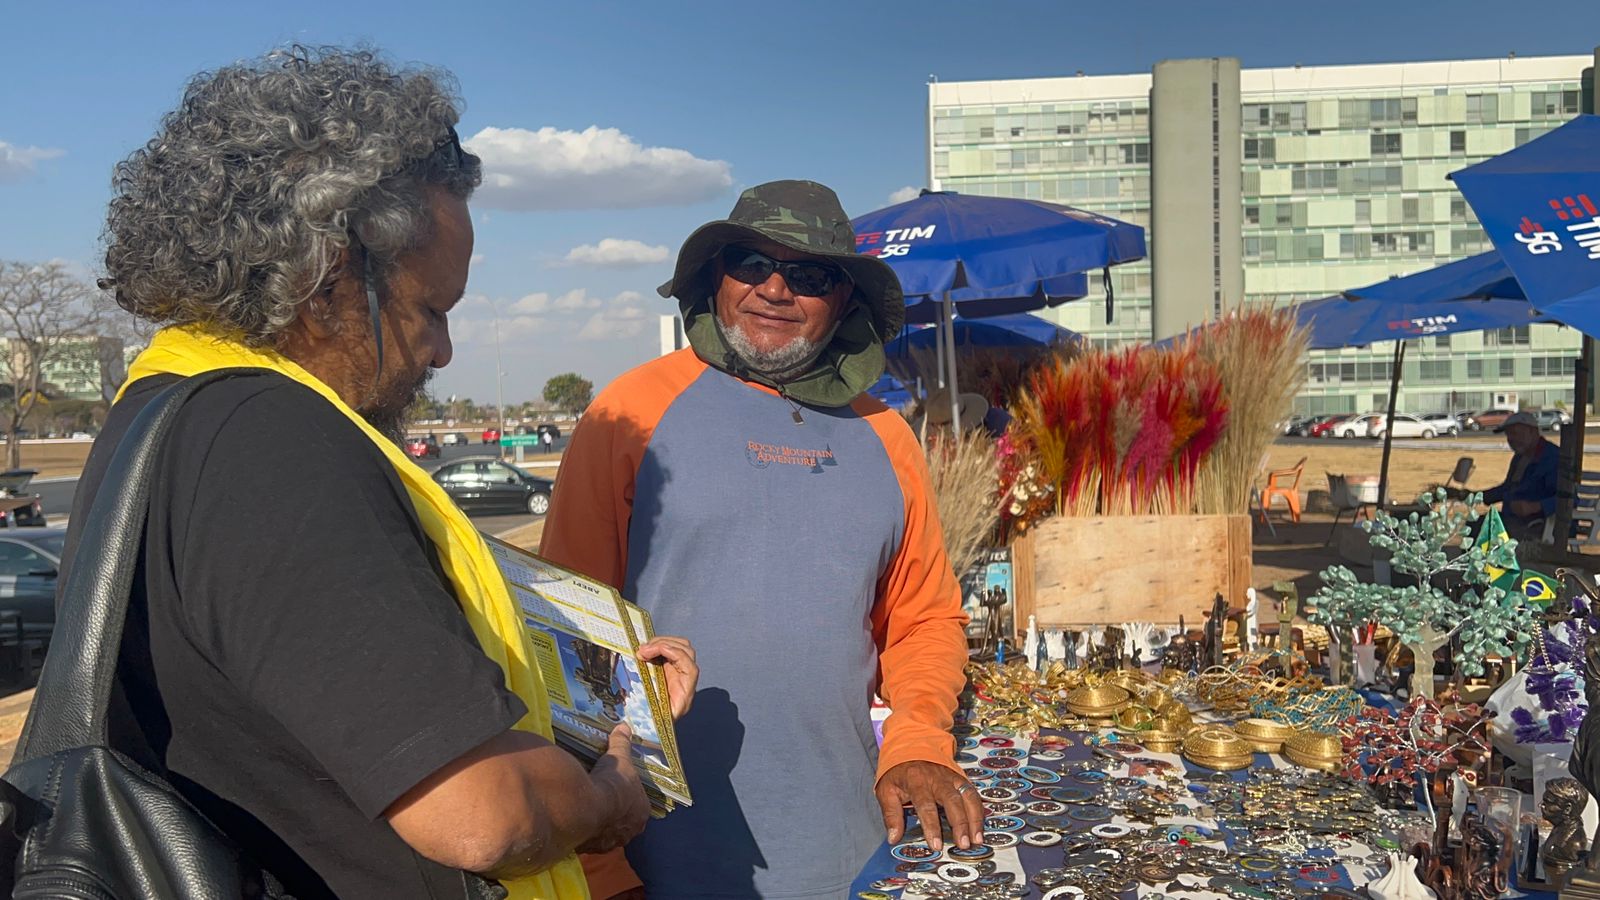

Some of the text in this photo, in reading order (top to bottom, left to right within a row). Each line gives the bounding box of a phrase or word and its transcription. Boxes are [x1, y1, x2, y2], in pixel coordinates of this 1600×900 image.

[885, 224, 936, 243] TIM
[877, 243, 911, 259] 5G
[1514, 231, 1563, 255] 5G
[1411, 314, 1457, 327] TIM
[748, 441, 832, 458] ROCKY MOUNTAIN
[757, 451, 816, 467] ADVENTURE
